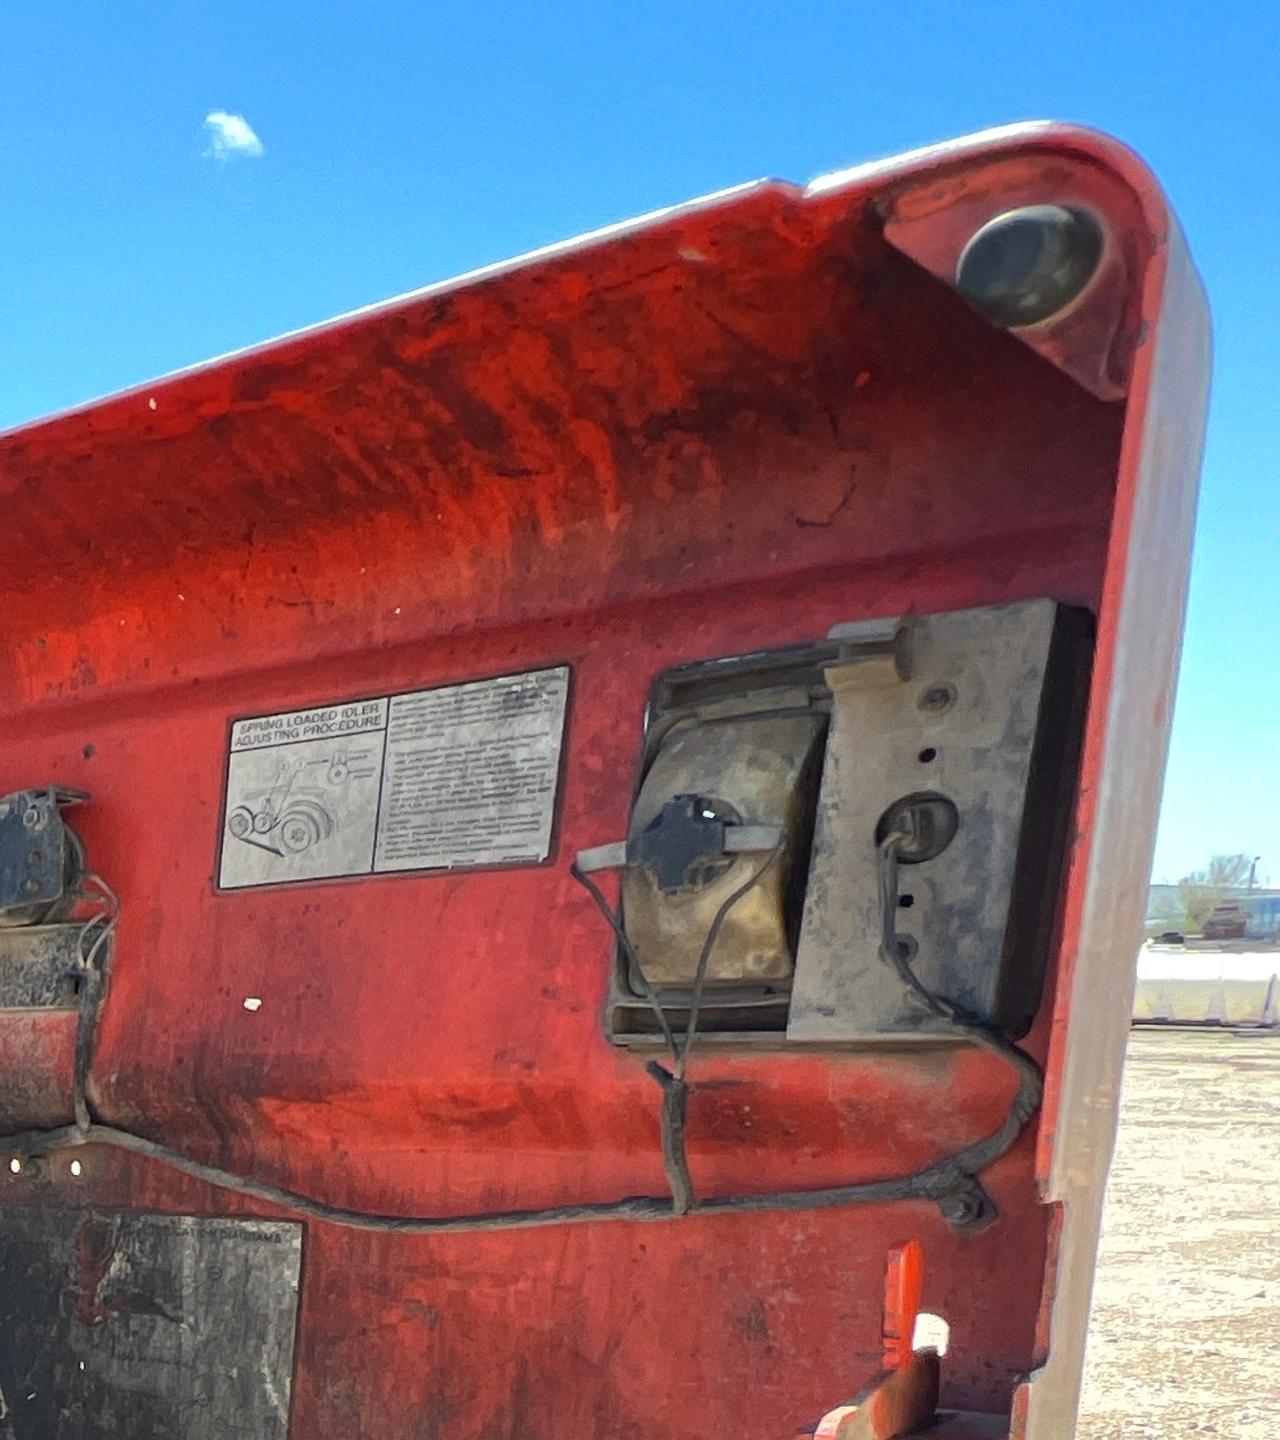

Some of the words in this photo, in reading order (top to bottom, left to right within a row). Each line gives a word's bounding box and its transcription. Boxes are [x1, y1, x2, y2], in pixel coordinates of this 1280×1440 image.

[234, 727, 299, 747] ADJUSTING
[302, 714, 381, 737] PROCEDURE
[239, 718, 283, 734] SPRING
[286, 710, 338, 728] LOADED
[341, 702, 380, 719] IDLER
